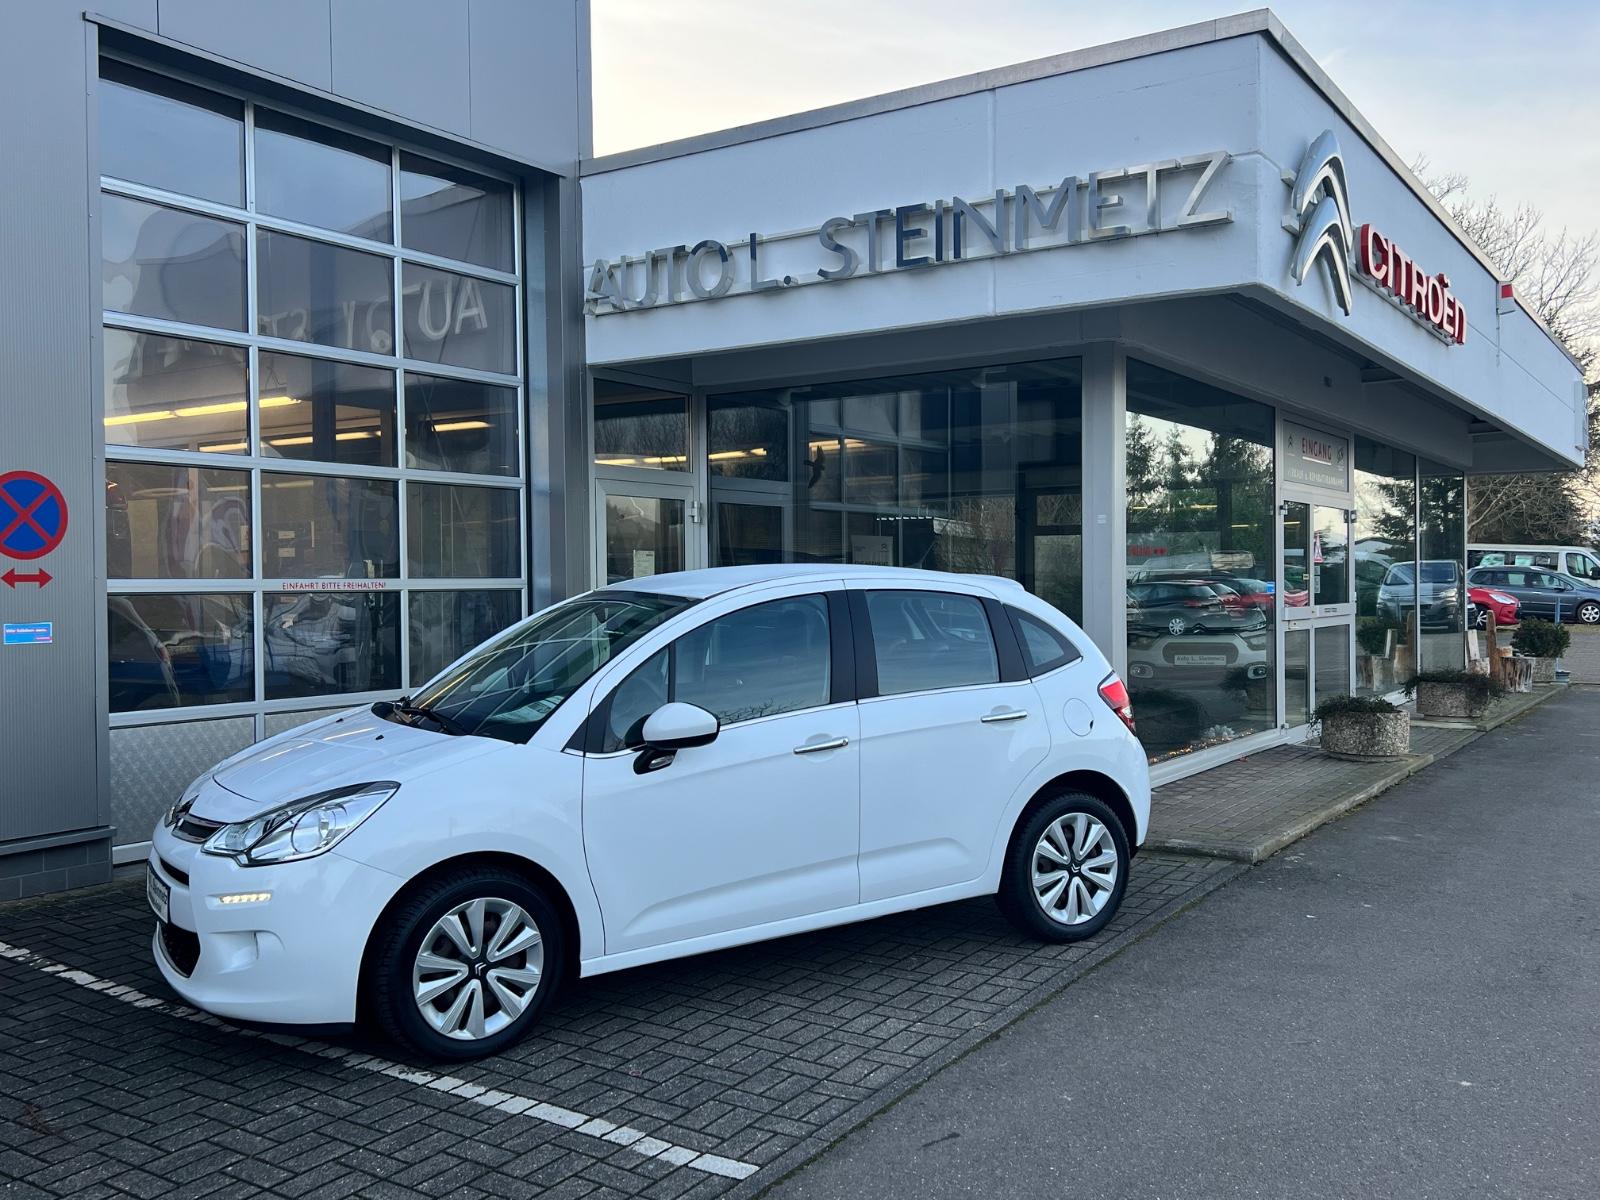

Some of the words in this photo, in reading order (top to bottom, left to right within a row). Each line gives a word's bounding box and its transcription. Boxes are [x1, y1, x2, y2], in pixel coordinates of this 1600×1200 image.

[583, 238, 736, 314] AUTO
[750, 232, 799, 292] L.
[817, 150, 1234, 280] STEINMETZ
[1360, 223, 1468, 345] CITROËN
[1302, 437, 1332, 461] EINGANG
[282, 582, 319, 590] EINFAHRT
[321, 582, 341, 590] BITTE
[343, 581, 386, 590] FREIHALTEN!
